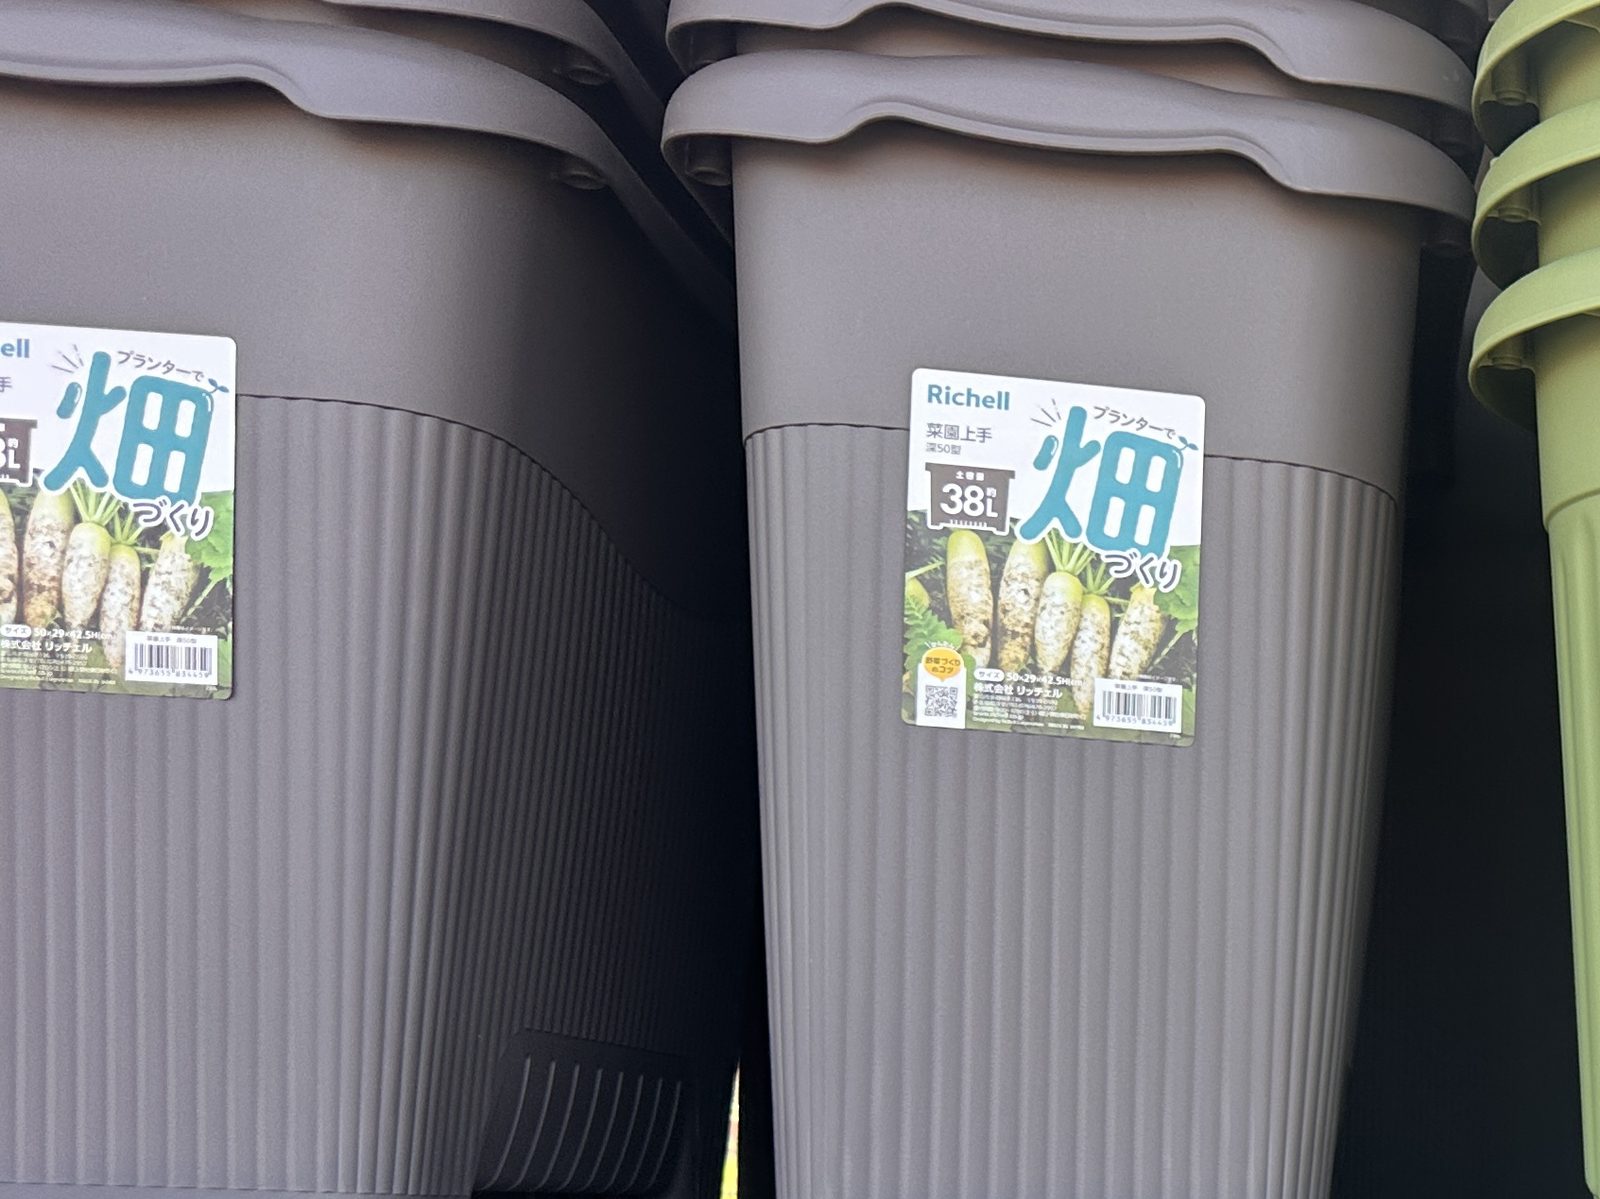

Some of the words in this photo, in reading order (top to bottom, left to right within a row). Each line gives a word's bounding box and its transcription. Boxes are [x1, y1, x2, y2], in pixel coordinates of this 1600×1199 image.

[116, 350, 204, 382] プランターで
[927, 383, 1011, 411] Richell
[43, 350, 215, 508] 畑
[926, 422, 993, 444] 菜園上手
[1093, 405, 1176, 440] プランターで
[1019, 405, 1184, 559] 畑
[132, 499, 211, 537] づくり
[1104, 551, 1178, 589] づくり
[45, 640, 93, 654] リッチェル
[1016, 685, 1063, 699] リッチェル
